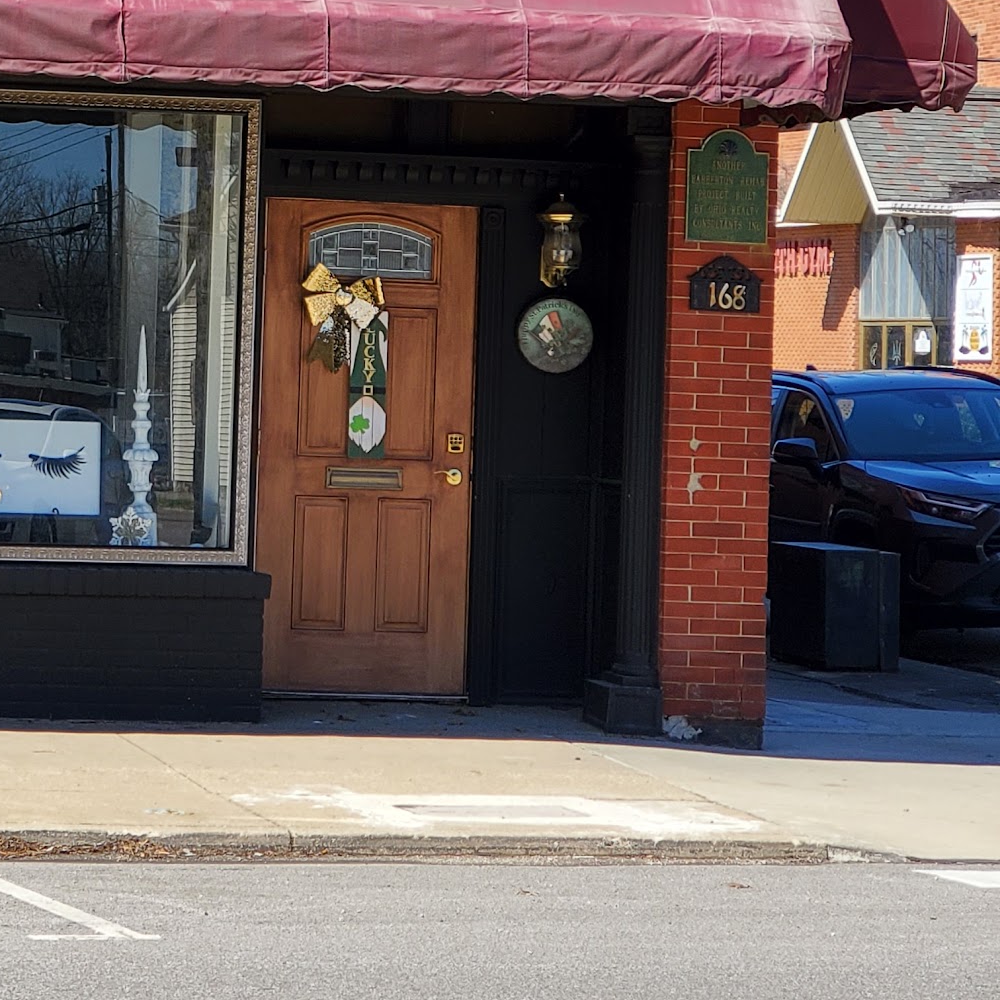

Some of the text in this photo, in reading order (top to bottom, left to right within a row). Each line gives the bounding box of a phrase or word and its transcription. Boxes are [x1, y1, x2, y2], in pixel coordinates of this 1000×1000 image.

[713, 160, 745, 171] ANOTHER
[697, 189, 756, 201] PROJECT BUILT
[694, 204, 703, 214] BY
[732, 206, 759, 217] REALTY
[692, 219, 742, 231] CONSULTANTS
[709, 281, 746, 311] 168
